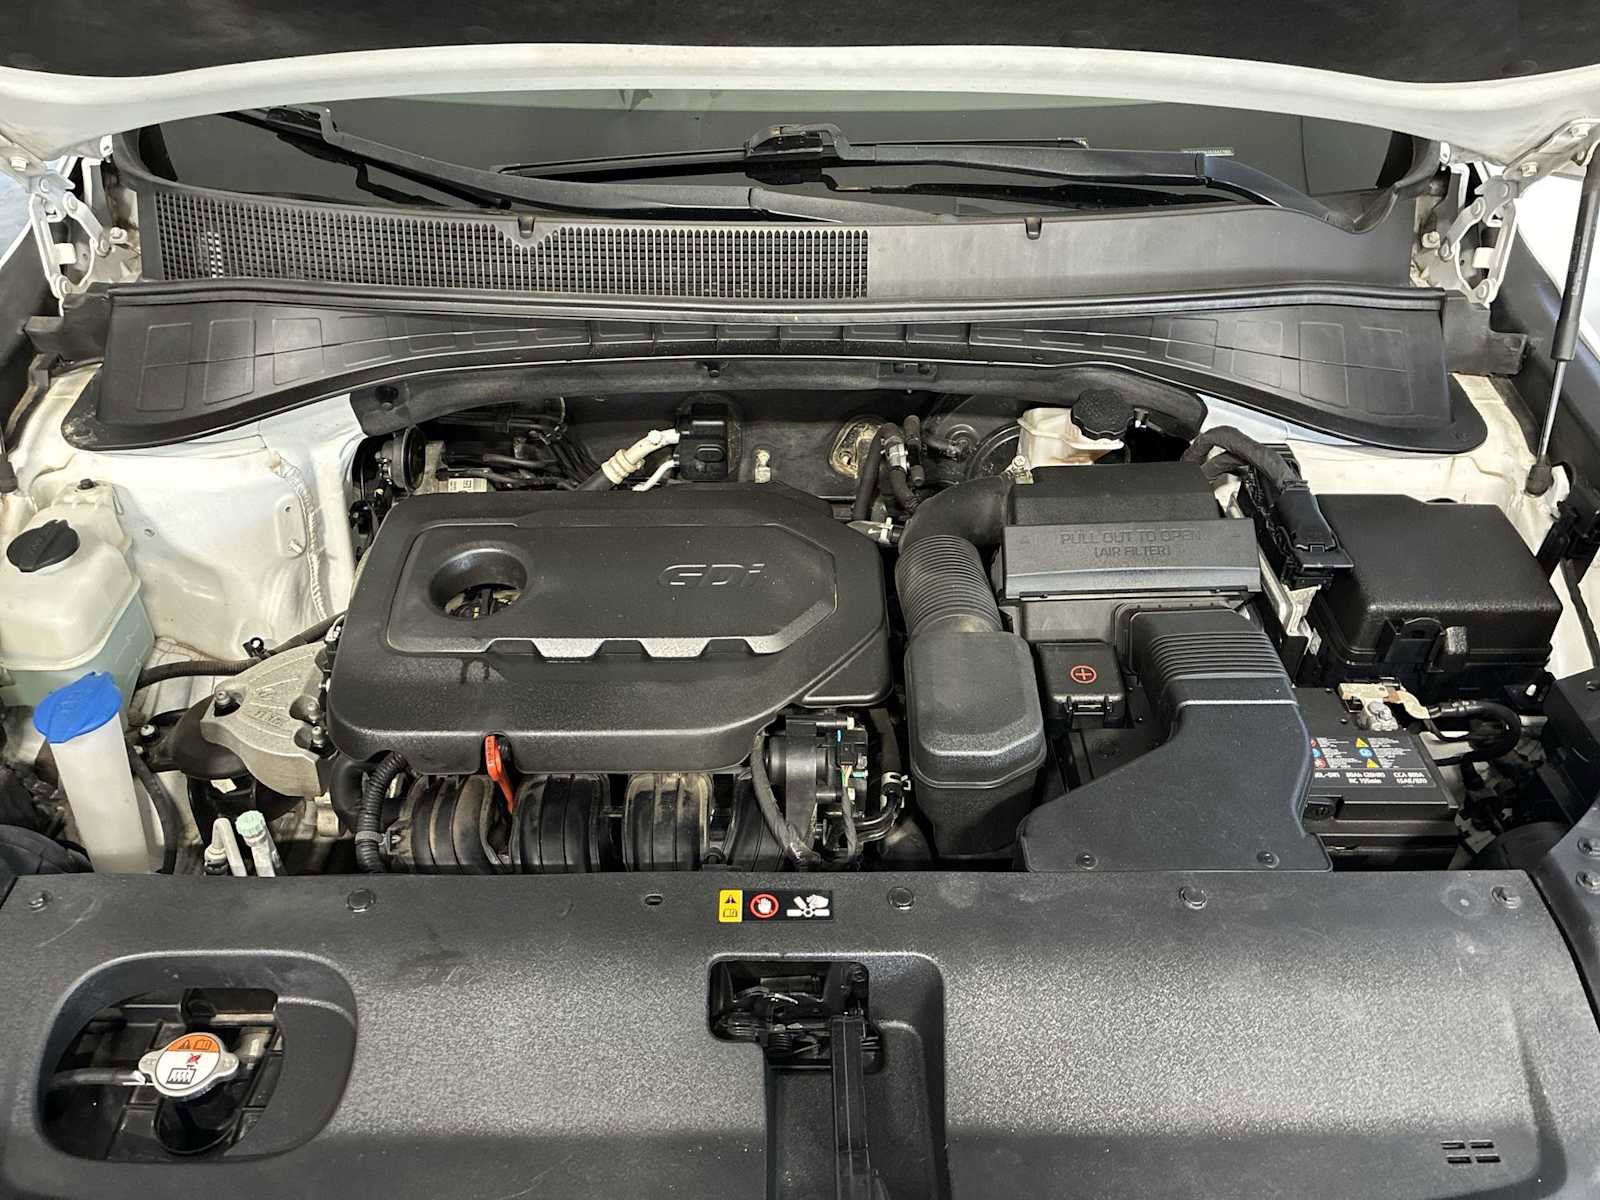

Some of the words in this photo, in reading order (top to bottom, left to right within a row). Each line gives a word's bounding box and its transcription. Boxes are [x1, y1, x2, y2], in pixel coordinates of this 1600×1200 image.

[1060, 532, 1097, 545] PULL
[1103, 530, 1132, 544] OUT
[1133, 529, 1157, 543] TO
[1161, 528, 1202, 542] OPEN
